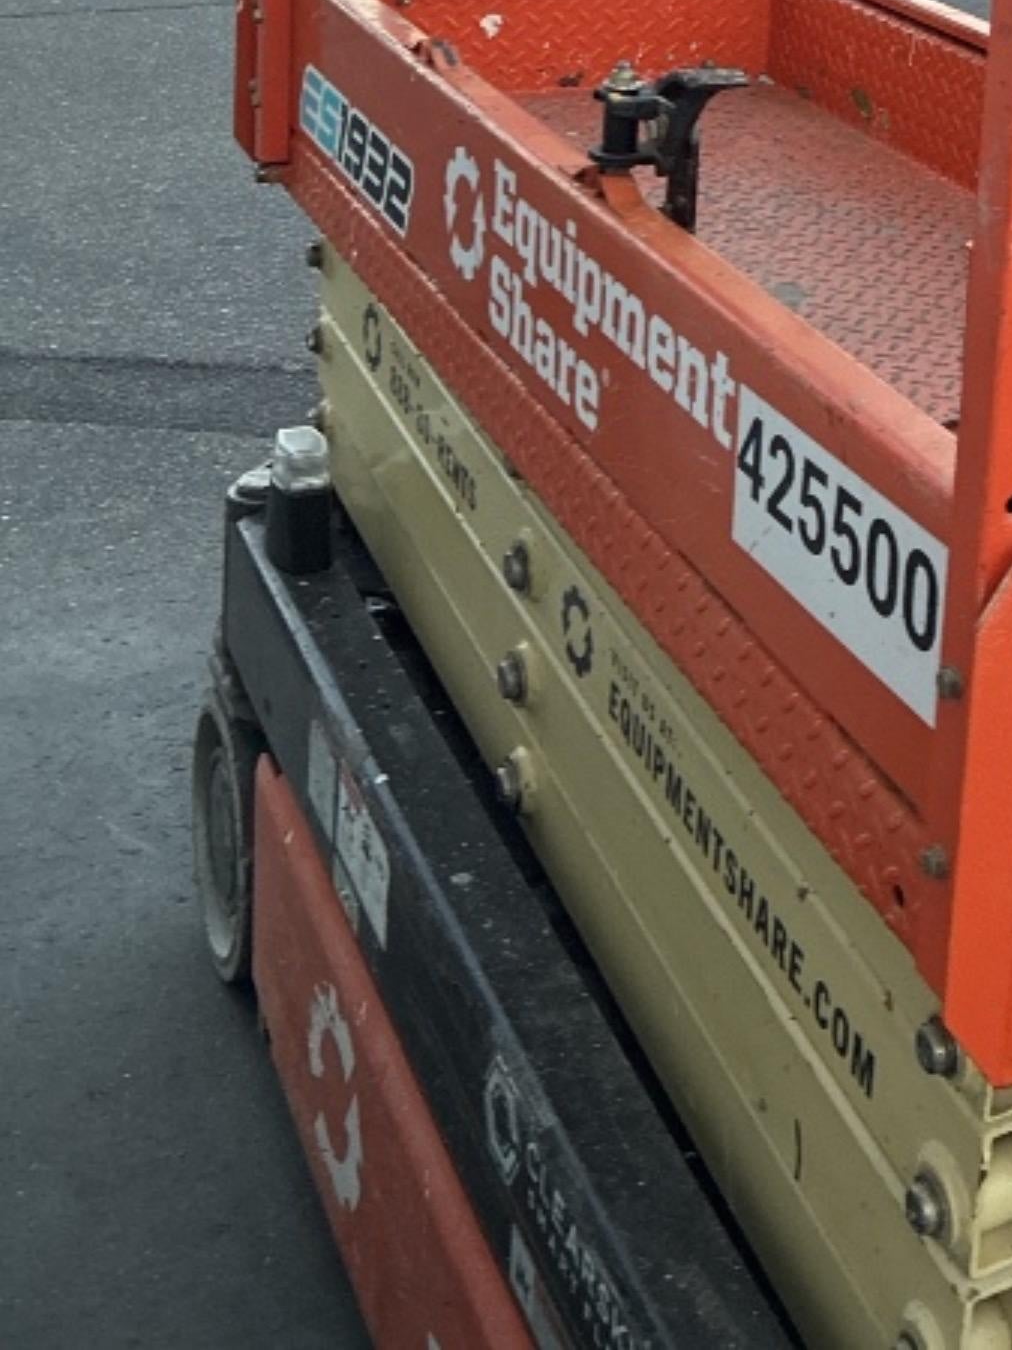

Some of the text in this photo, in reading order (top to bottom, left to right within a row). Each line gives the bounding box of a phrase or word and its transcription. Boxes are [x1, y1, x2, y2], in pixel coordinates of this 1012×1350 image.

[489, 254, 600, 432] Share
[492, 158, 735, 449] Equipment
[737, 417, 939, 652] 425500
[608, 681, 877, 1099] EQUIPMENTSHARE.COM
